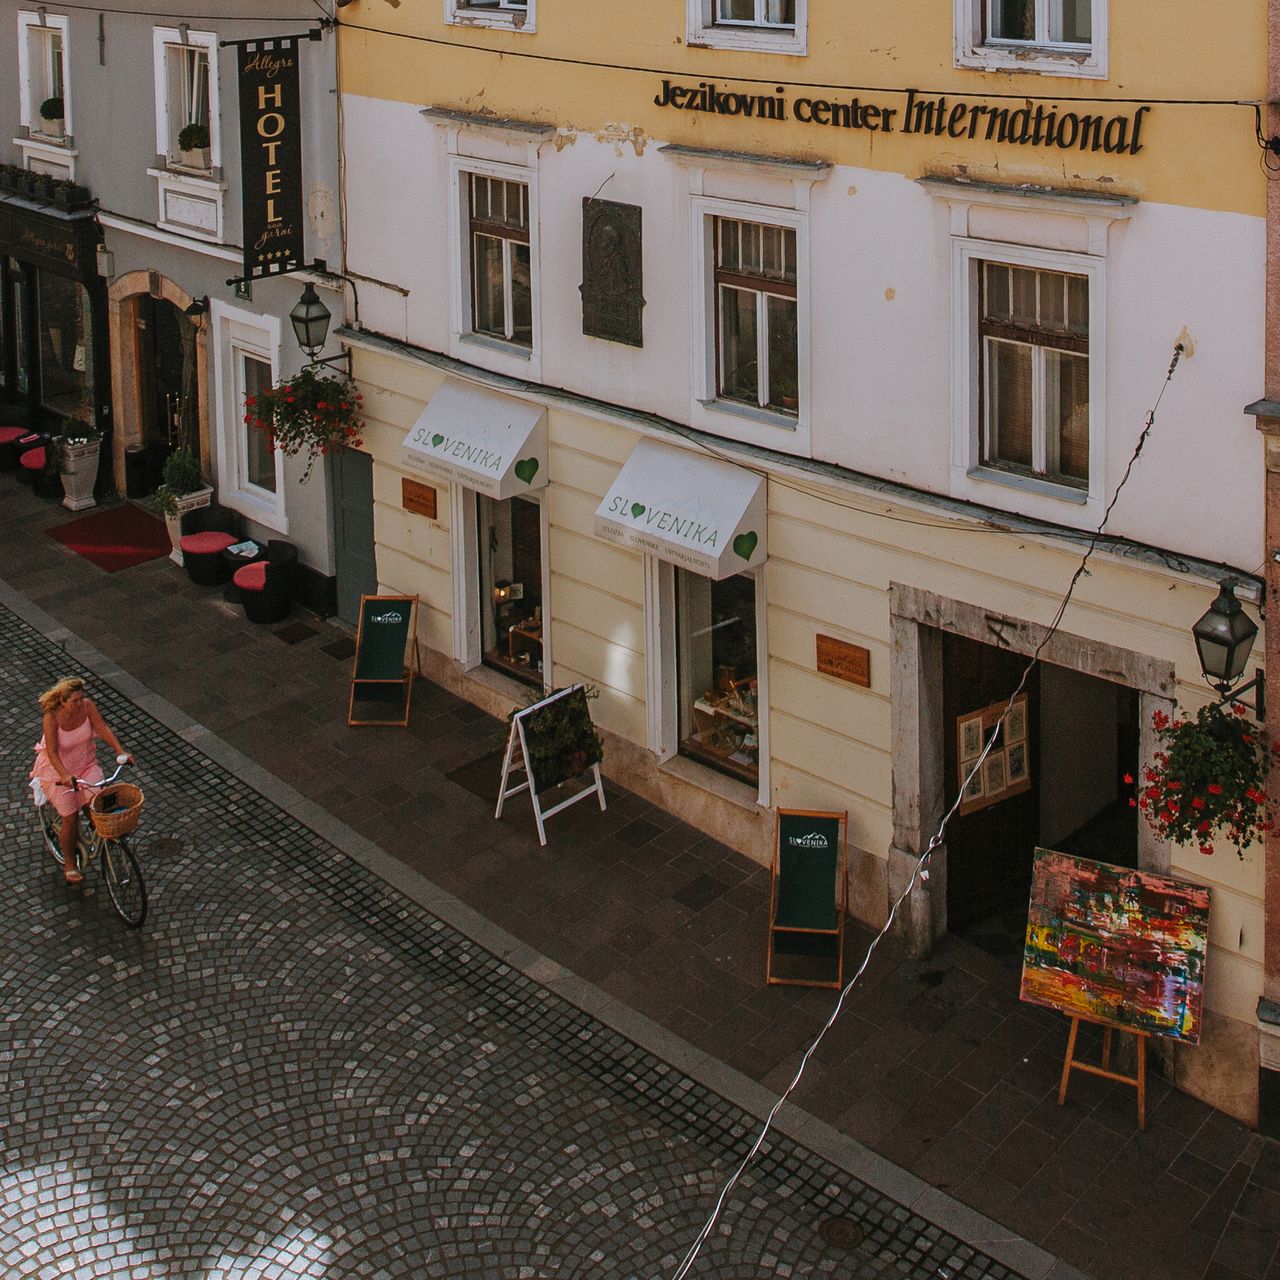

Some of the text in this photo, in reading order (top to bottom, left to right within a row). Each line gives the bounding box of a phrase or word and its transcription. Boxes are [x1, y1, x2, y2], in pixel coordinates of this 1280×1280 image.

[256, 84, 286, 223] HOTEL
[654, 80, 1151, 156] Jezikovni center International
